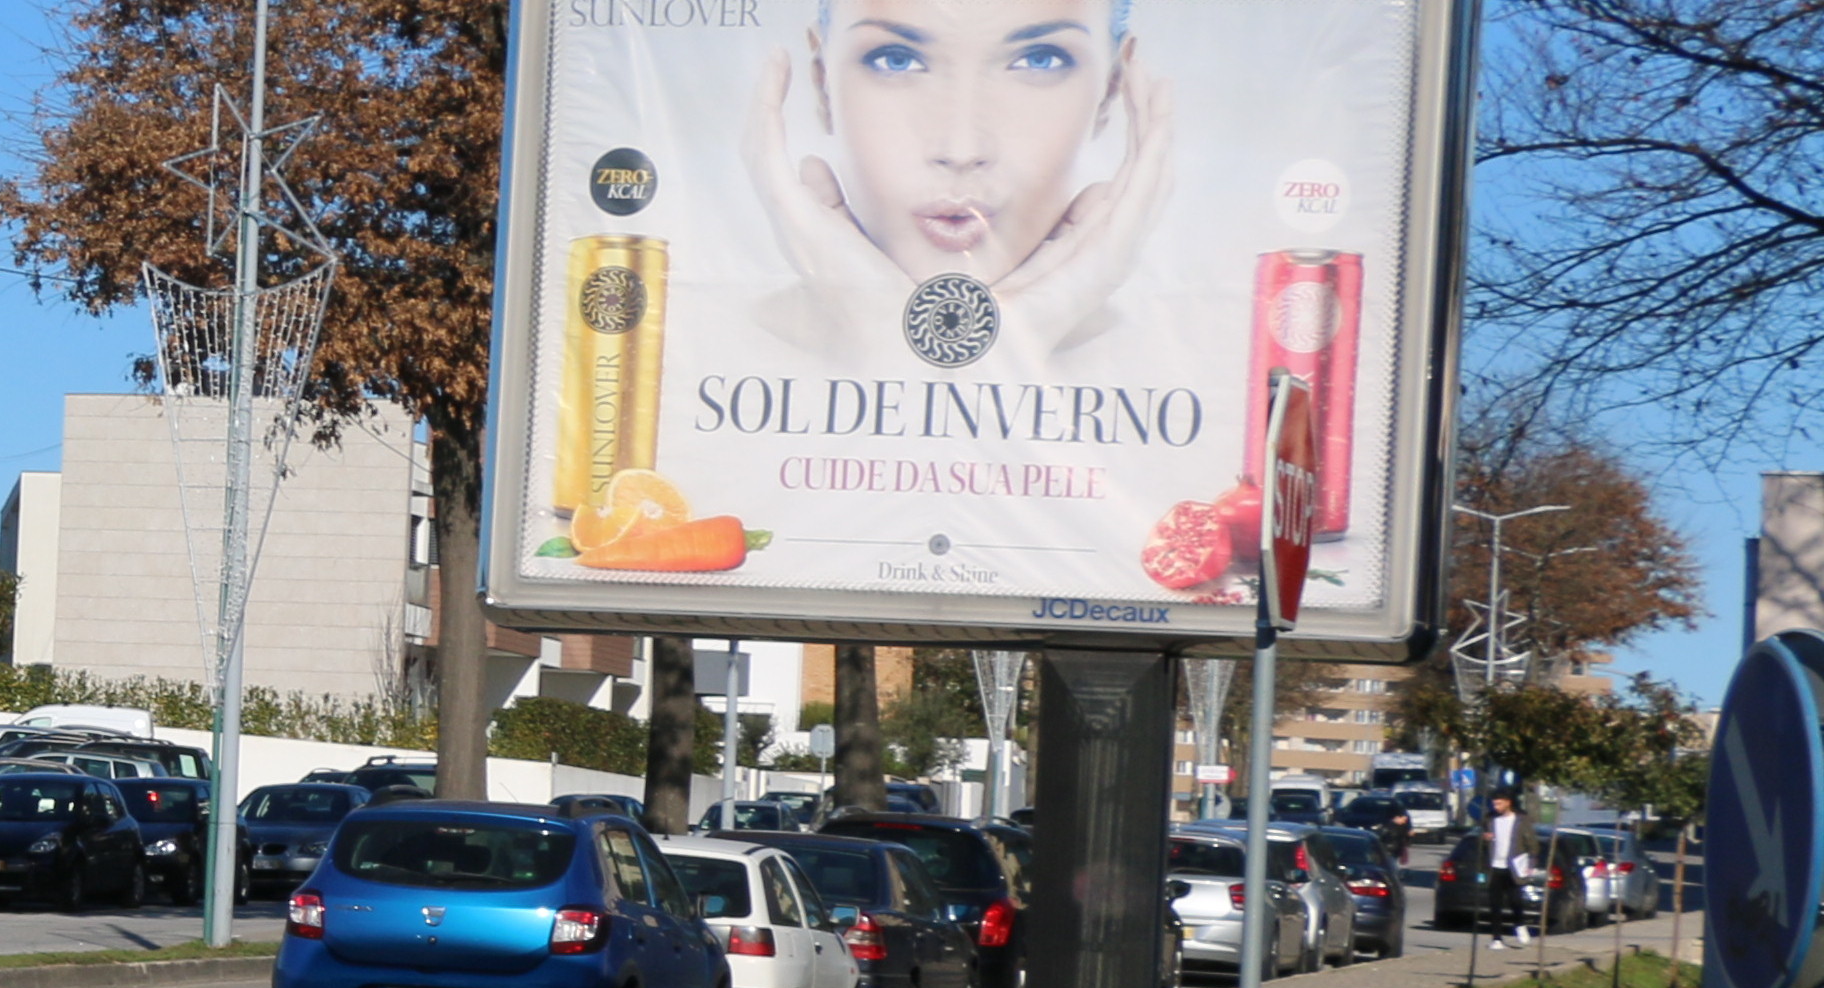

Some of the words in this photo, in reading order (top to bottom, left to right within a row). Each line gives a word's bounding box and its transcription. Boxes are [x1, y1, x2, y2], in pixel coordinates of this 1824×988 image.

[568, 0, 762, 28] SUNLOVER
[596, 168, 650, 185] ZERO
[1282, 181, 1341, 199] ZERO
[606, 184, 648, 200] KCAL
[1296, 198, 1339, 214] KCAL
[591, 353, 621, 493] SUNLOVER
[695, 374, 810, 434] SOL
[820, 378, 906, 437] DE
[917, 380, 1202, 448] INVERNO
[779, 455, 887, 491] CUIDE
[893, 460, 942, 493] DA
[947, 461, 1014, 497] SUA
[1021, 463, 1107, 500] PELE
[1273, 457, 1314, 548] STOP
[877, 560, 927, 581] Drink
[932, 565, 945, 581] &
[950, 564, 999, 584] Shine
[1031, 597, 1170, 624] JCDecaux
